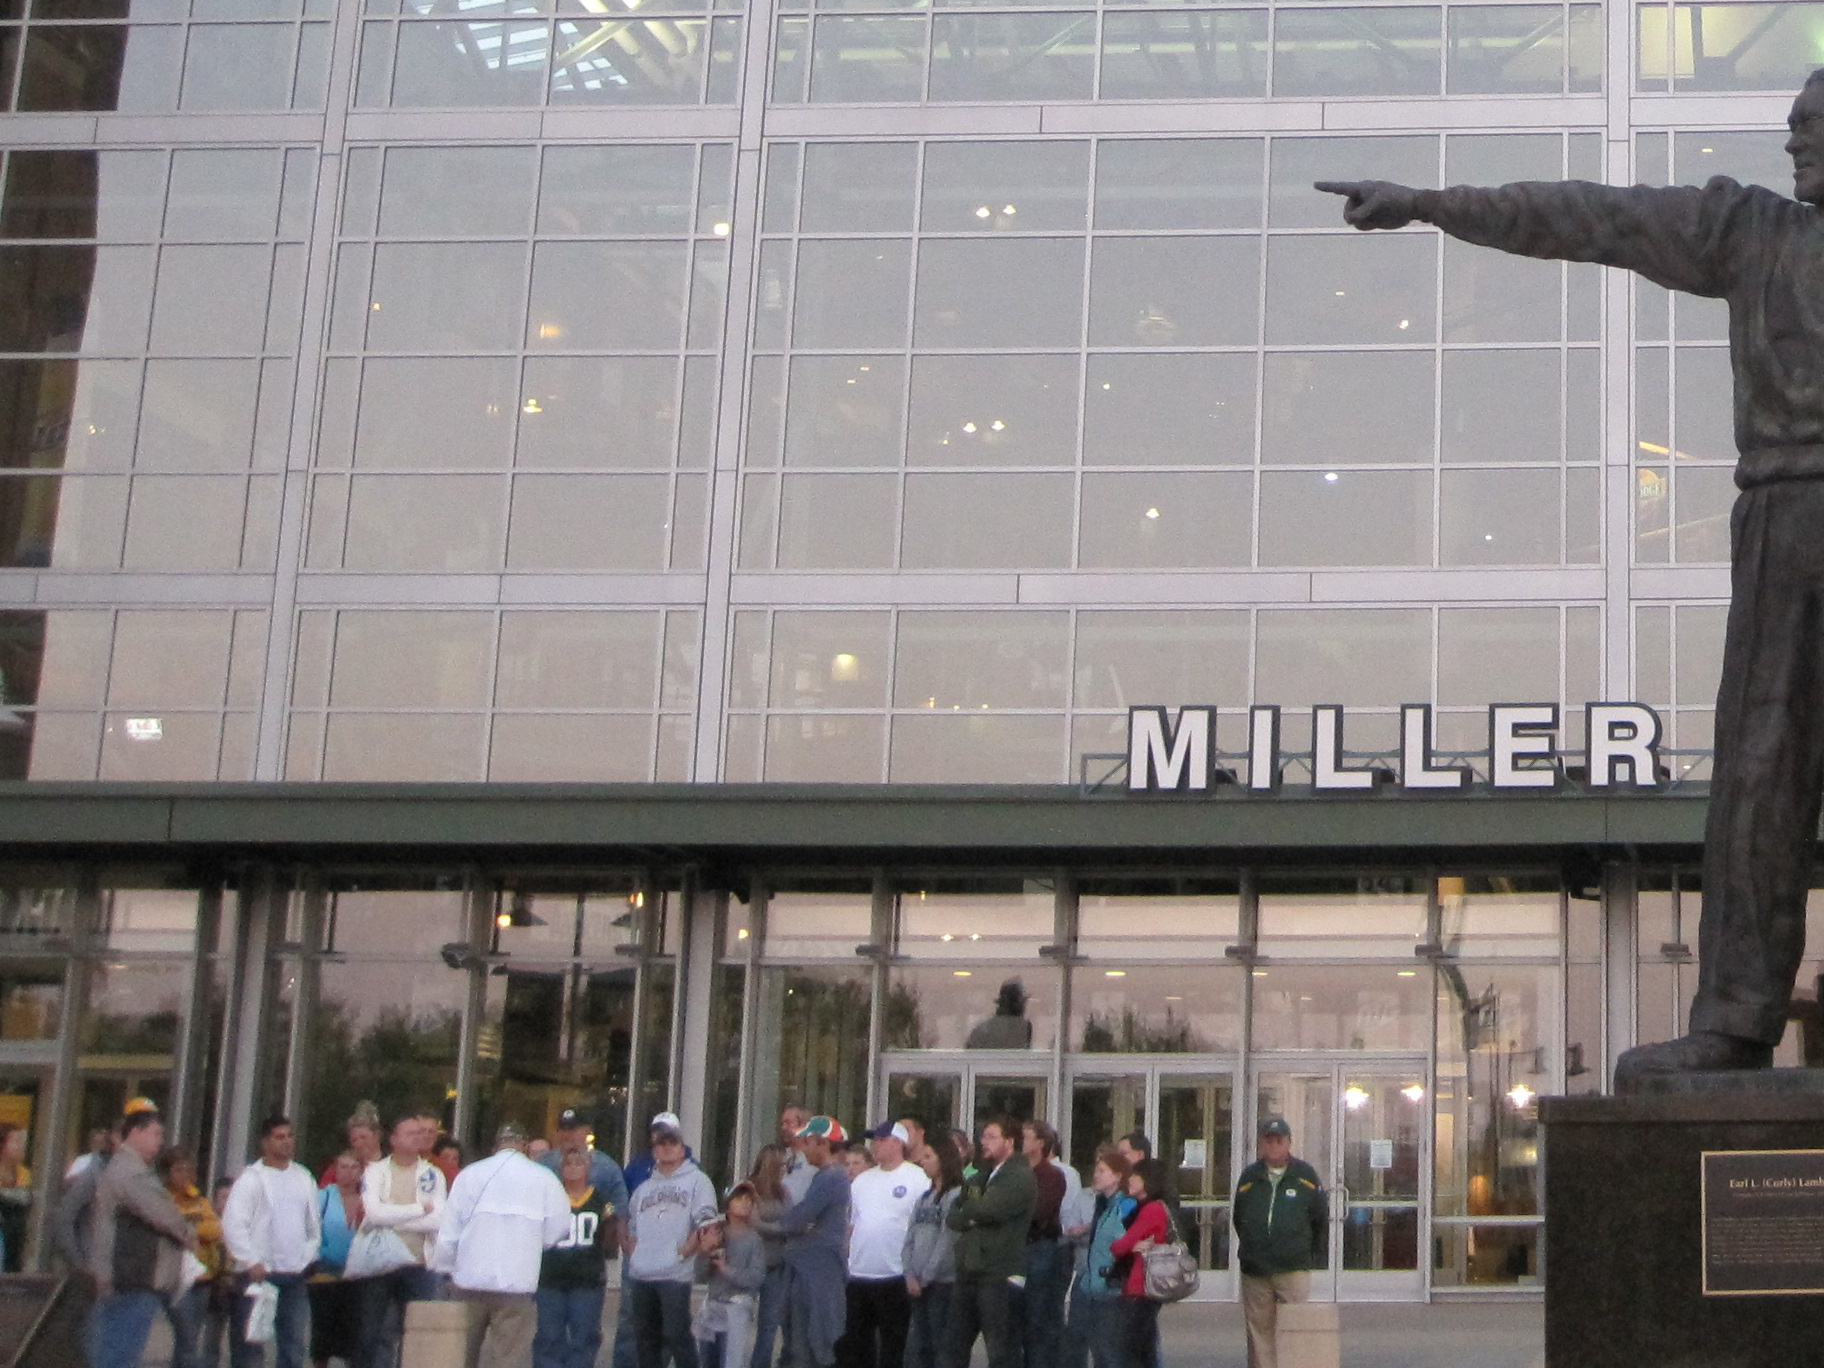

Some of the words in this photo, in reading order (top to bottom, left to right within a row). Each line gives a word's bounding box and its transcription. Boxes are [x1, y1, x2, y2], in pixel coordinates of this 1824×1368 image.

[1129, 702, 1663, 791] MILLER
[1729, 1177, 1748, 1188] Earl
[1762, 1177, 1796, 1190] (Curly)
